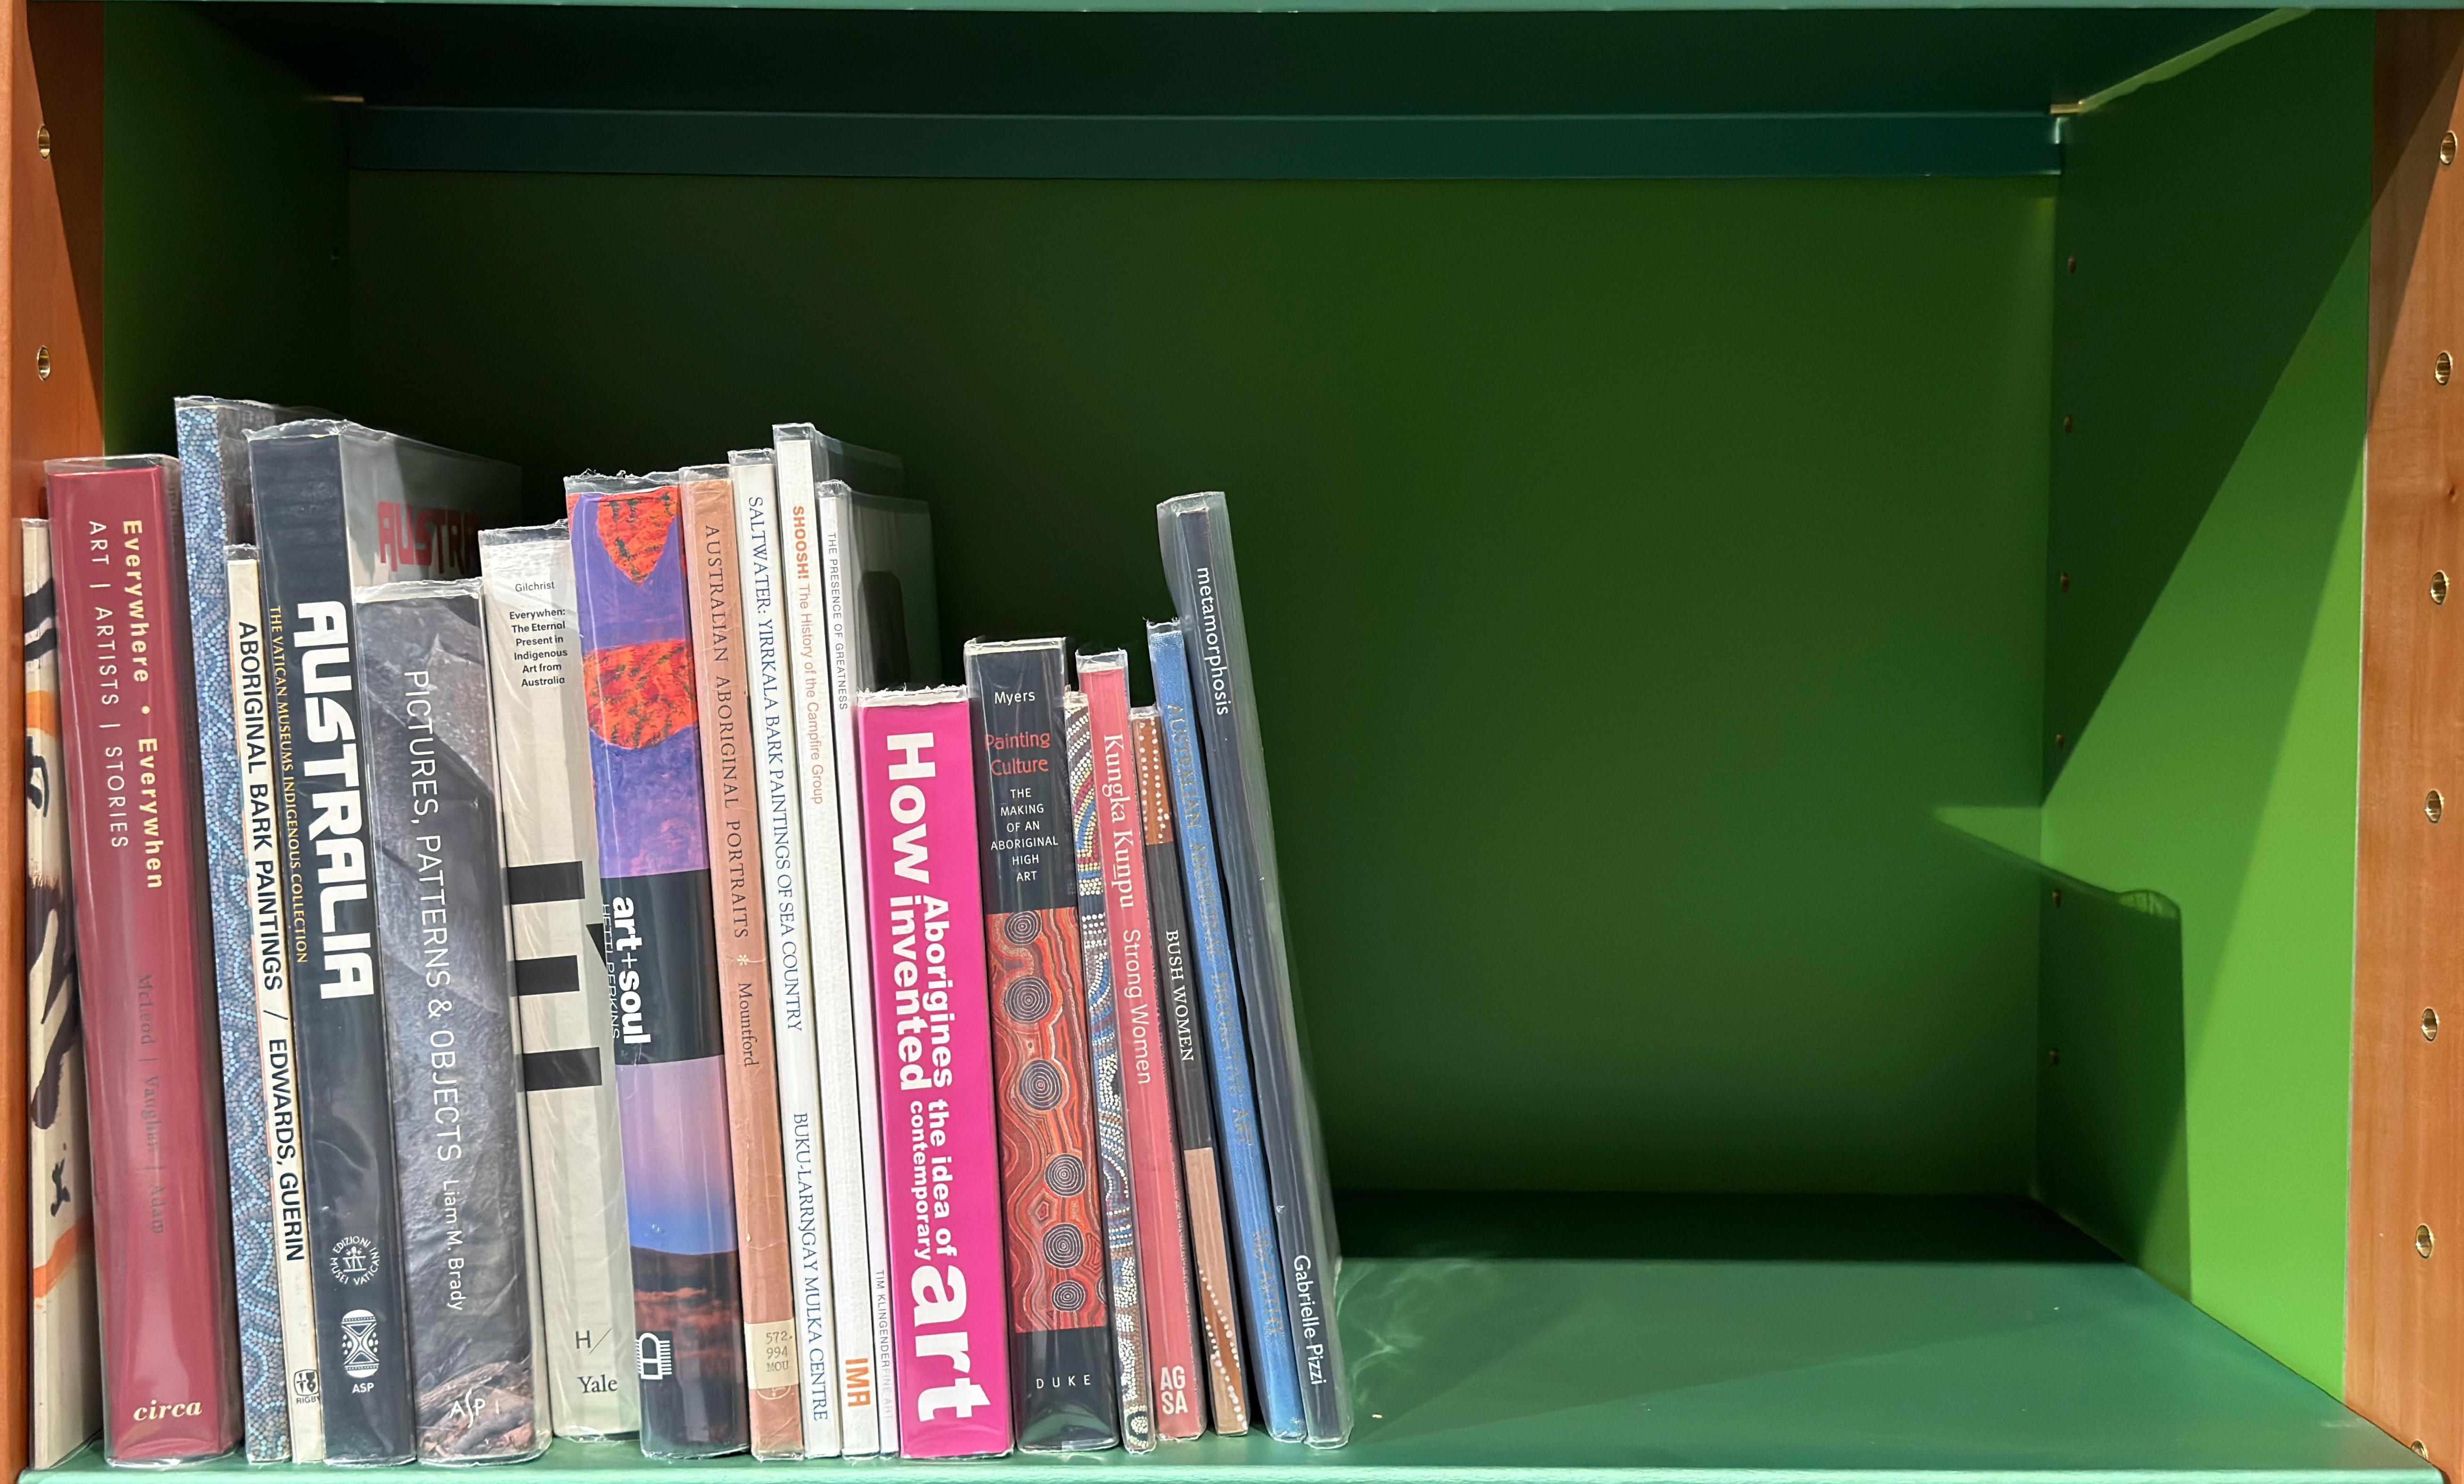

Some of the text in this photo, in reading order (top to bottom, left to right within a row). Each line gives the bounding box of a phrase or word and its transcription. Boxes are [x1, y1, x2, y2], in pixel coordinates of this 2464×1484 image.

[89, 521, 109, 565] ART
[510, 609, 566, 620] Everywhen:
[515, 581, 555, 592] Gilchrist
[511, 621, 565, 633] The Eternal
[516, 635, 564, 646] Present in
[828, 532, 848, 710] THE PRESENCE OF GREATNESS
[1197, 567, 1231, 716] metamorphosis
[95, 606, 119, 705] ARTISTS
[514, 649, 568, 661] Indigenous
[521, 677, 565, 687] Australia
[523, 663, 561, 673] Art from
[793, 506, 824, 805] SHOOSH! The History of the Campfire Group
[123, 520, 149, 682] Everywhere
[138, 738, 164, 888] Everywhen
[239, 621, 267, 774] ABORIGINAL
[995, 691, 1035, 706] Myers
[749, 497, 802, 1031] SALTWATER: YIRRKALA BARK PAINTINGS OF SEA COUNTRY
[984, 731, 1051, 751] Painting
[991, 758, 1049, 776] Culture
[105, 746, 129, 847] STORIES
[270, 605, 308, 963] THE VATICAN MUSEUMS INDIGENOUS COLLECTION
[293, 600, 374, 999] AUSTRALIA
[705, 525, 759, 1068] AUSTRALIAN ABORIGINAL PORTRAITS Mountford
[1010, 788, 1031, 798] THE
[1102, 733, 1131, 823] Kungka
[250, 783, 273, 851] BARK
[886, 732, 936, 885] How
[1001, 804, 1044, 816] MAKING
[1007, 821, 1040, 832] OF AN
[990, 836, 1058, 851] ABORIGINAL
[1013, 854, 1039, 865] HIGH
[1016, 871, 1037, 882] ART
[255, 860, 283, 991] PAINTINGS
[405, 670, 466, 1311] PICTURES, PATTERNS & OBJECTS Liam M. Brady
[602, 904, 620, 1039] HETTI PERKINS
[613, 897, 651, 1044] art+soul
[890, 895, 932, 1090] invented
[922, 895, 955, 1088] Aborigines
[1123, 929, 1142, 999] Strong
[1166, 929, 1194, 1061] BUSH WOMEN
[1130, 1003, 1151, 1085] Women
[269, 1039, 296, 1164] EDWARDS,
[910, 1100, 931, 1261] contemporary
[928, 1098, 957, 1257] the idea of
[280, 1172, 305, 1261] GUERIN
[333, 1235, 371, 1254] EDIZIONI
[331, 1258, 349, 1284] MUSEI
[354, 1247, 380, 1285] VATICANI
[875, 1270, 885, 1289] TIM
[766, 1331, 793, 1345] 572.
[805, 1277, 822, 1343] MULKA
[1294, 1255, 1327, 1385] Gabrielle Pizzi
[766, 1361, 789, 1372] MOU
[767, 1346, 788, 1359] 994
[911, 1265, 991, 1422] art
[352, 1382, 374, 1394] ASP
[577, 1374, 618, 1394] Yale
[810, 1348, 827, 1421] CENTRE
[845, 1358, 871, 1407] IMA
[1036, 1374, 1091, 1389] DUKE
[1160, 1365, 1186, 1391] AG
[1161, 1390, 1188, 1415] SA
[134, 1399, 202, 1421] circa
